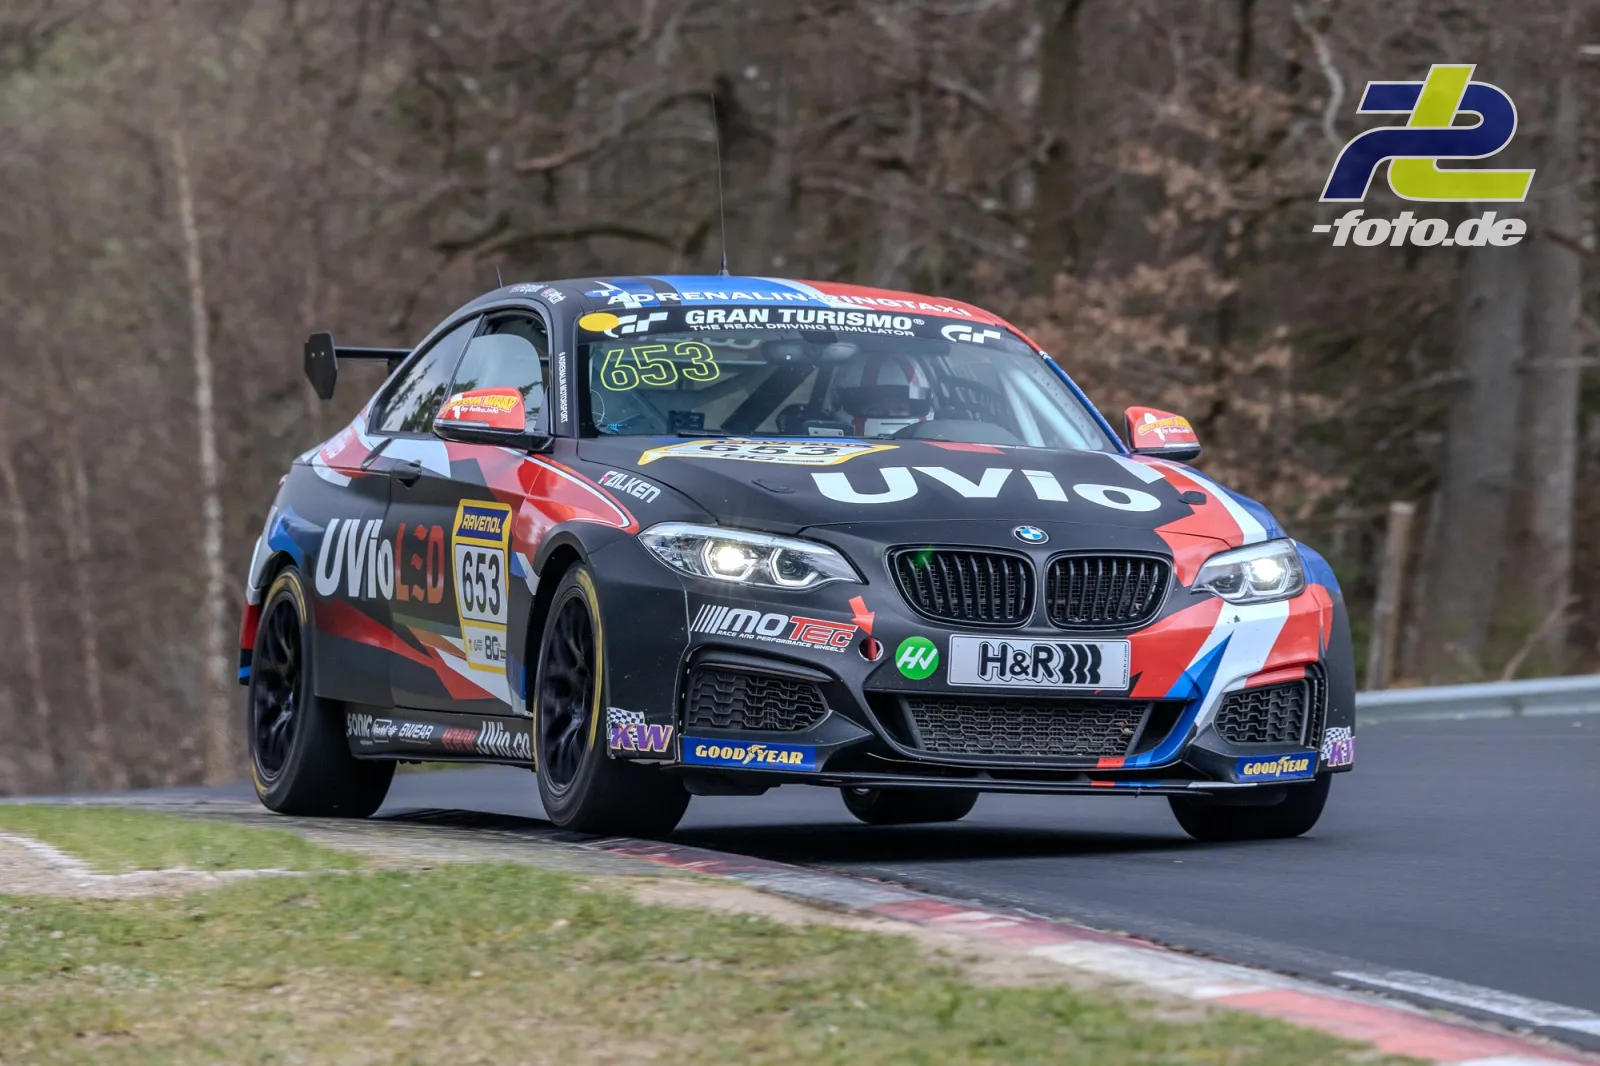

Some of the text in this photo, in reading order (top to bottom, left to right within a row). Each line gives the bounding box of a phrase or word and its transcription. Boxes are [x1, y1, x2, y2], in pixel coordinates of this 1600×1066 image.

[607, 291, 808, 306] ADRENALIN
[685, 309, 770, 325] GRAN
[690, 324, 721, 332] THE
[766, 323, 827, 331] DRIVING
[830, 325, 915, 337] SIMULATOR
[601, 341, 720, 391] 653
[700, 443, 841, 457] 653
[598, 470, 661, 504] FALKEN
[461, 513, 502, 533] RAVENOL
[462, 550, 500, 615] 653
[756, 635, 811, 648] PERFORMANCE
[814, 643, 846, 653] WHEELS
[979, 641, 1061, 683] H&R
[399, 723, 434, 740] BWEAR
[610, 722, 673, 753] KW
